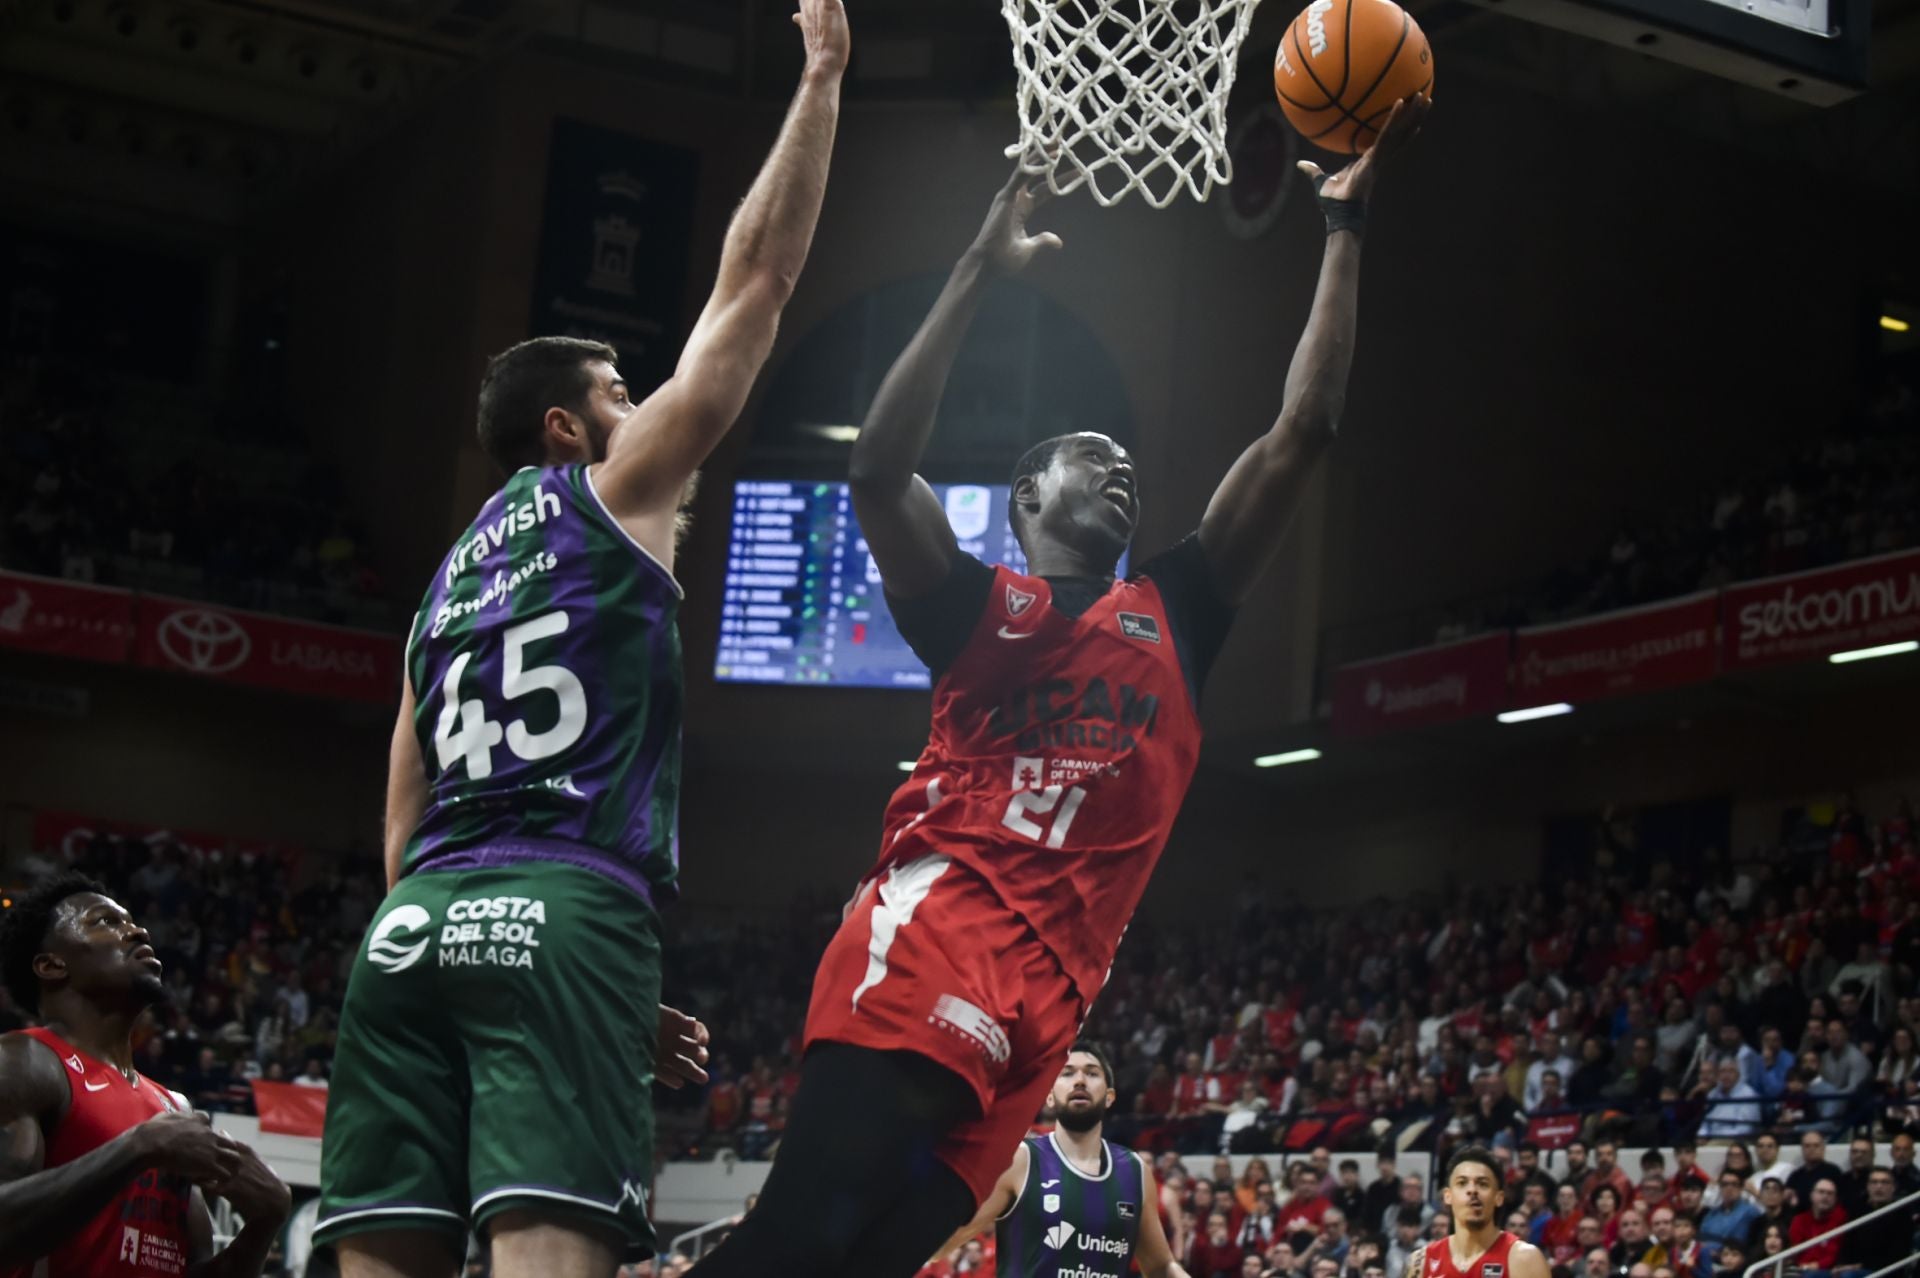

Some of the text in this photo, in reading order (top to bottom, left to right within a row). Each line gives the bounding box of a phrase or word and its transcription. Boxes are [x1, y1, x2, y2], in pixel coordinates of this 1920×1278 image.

[1738, 573, 1920, 640] setcomu
[434, 610, 588, 781] 45
[1051, 758, 1112, 772] CARAVA
[1001, 784, 1087, 849] 21
[446, 896, 546, 924] COSTA
[440, 921, 540, 947] DEL SOL
[438, 940, 534, 970] MÁLAGA
[1077, 1232, 1128, 1258] Unicaja
